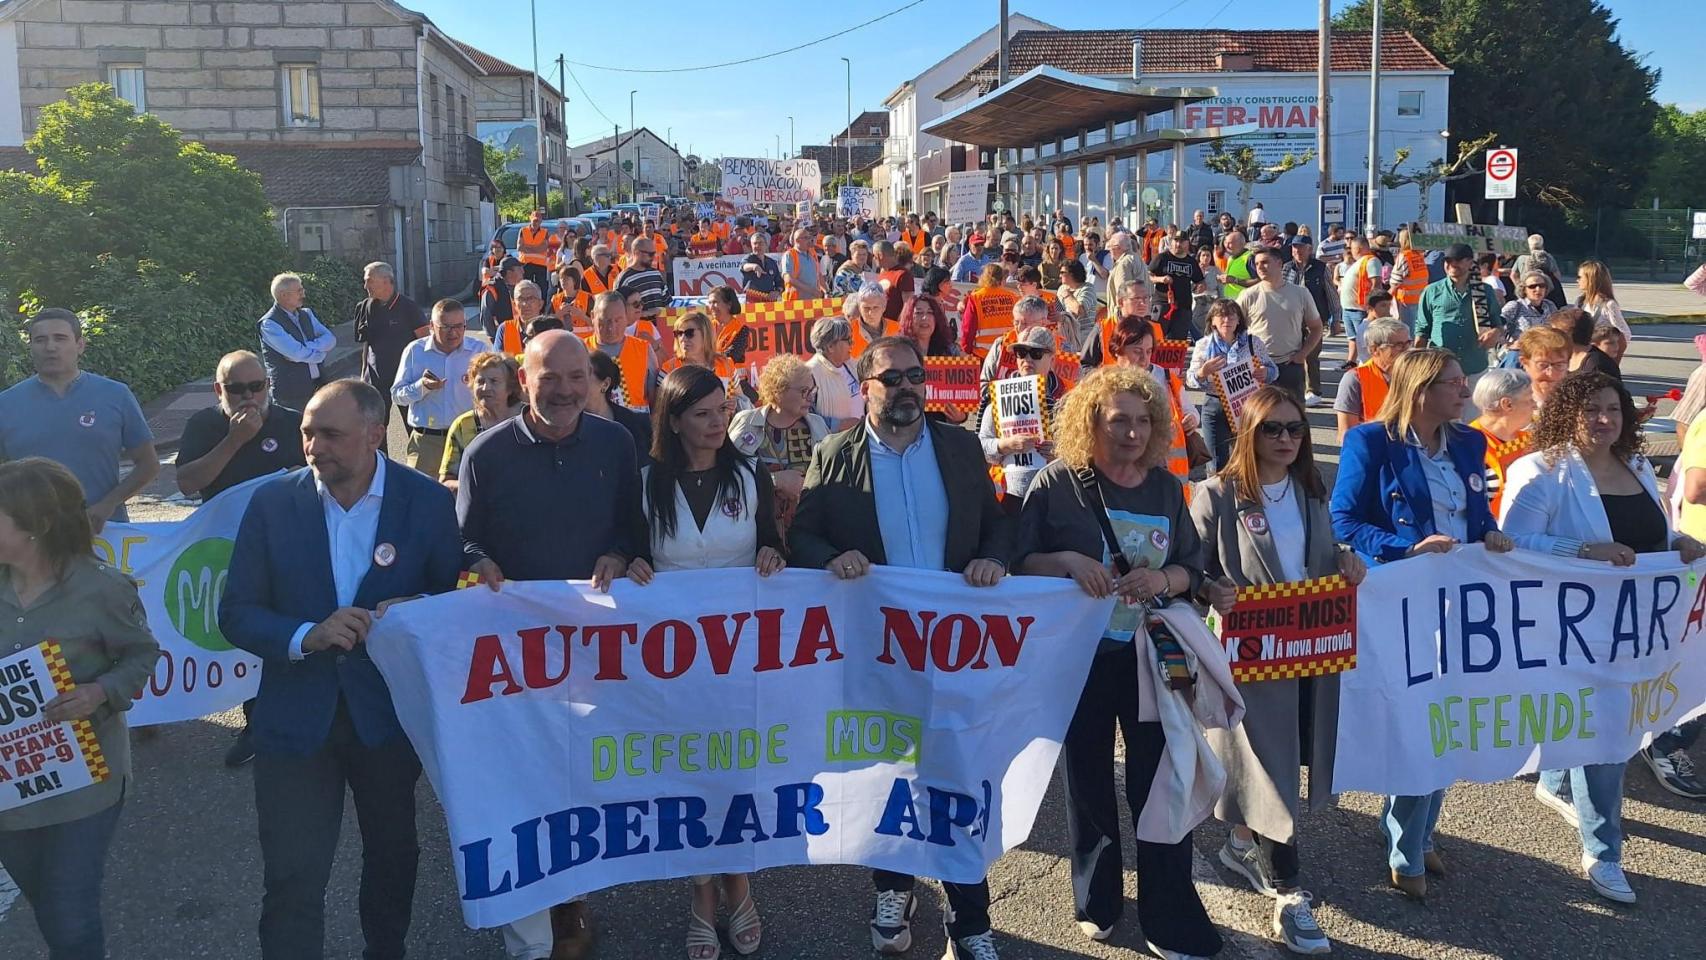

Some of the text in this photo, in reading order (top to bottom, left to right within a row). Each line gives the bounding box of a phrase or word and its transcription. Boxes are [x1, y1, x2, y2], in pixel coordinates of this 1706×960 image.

[725, 158, 782, 177] BEMBRIVE
[796, 162, 817, 177] MOS
[1223, 362, 1250, 380] DEFENDE
[1226, 370, 1255, 395] MOS!
[1000, 380, 1033, 395] DEFENDE
[1001, 393, 1035, 418] MOS!
[1014, 453, 1033, 467] XA!
[1227, 605, 1295, 632] DEFENDE
[1299, 594, 1354, 631] MOS!
[1286, 638, 1312, 658] NOVA
[1314, 629, 1353, 655] AUTOVÍA
[1402, 574, 1681, 688] LIBERAR
[460, 605, 1036, 704] AUTOVIA NON
[1428, 686, 1596, 759] DEFENDE
[14, 743, 75, 779] AP-9
[592, 715, 916, 782] DEFENDE MOS
[14, 770, 63, 800] XA!
[458, 780, 830, 901] LIBERAR
